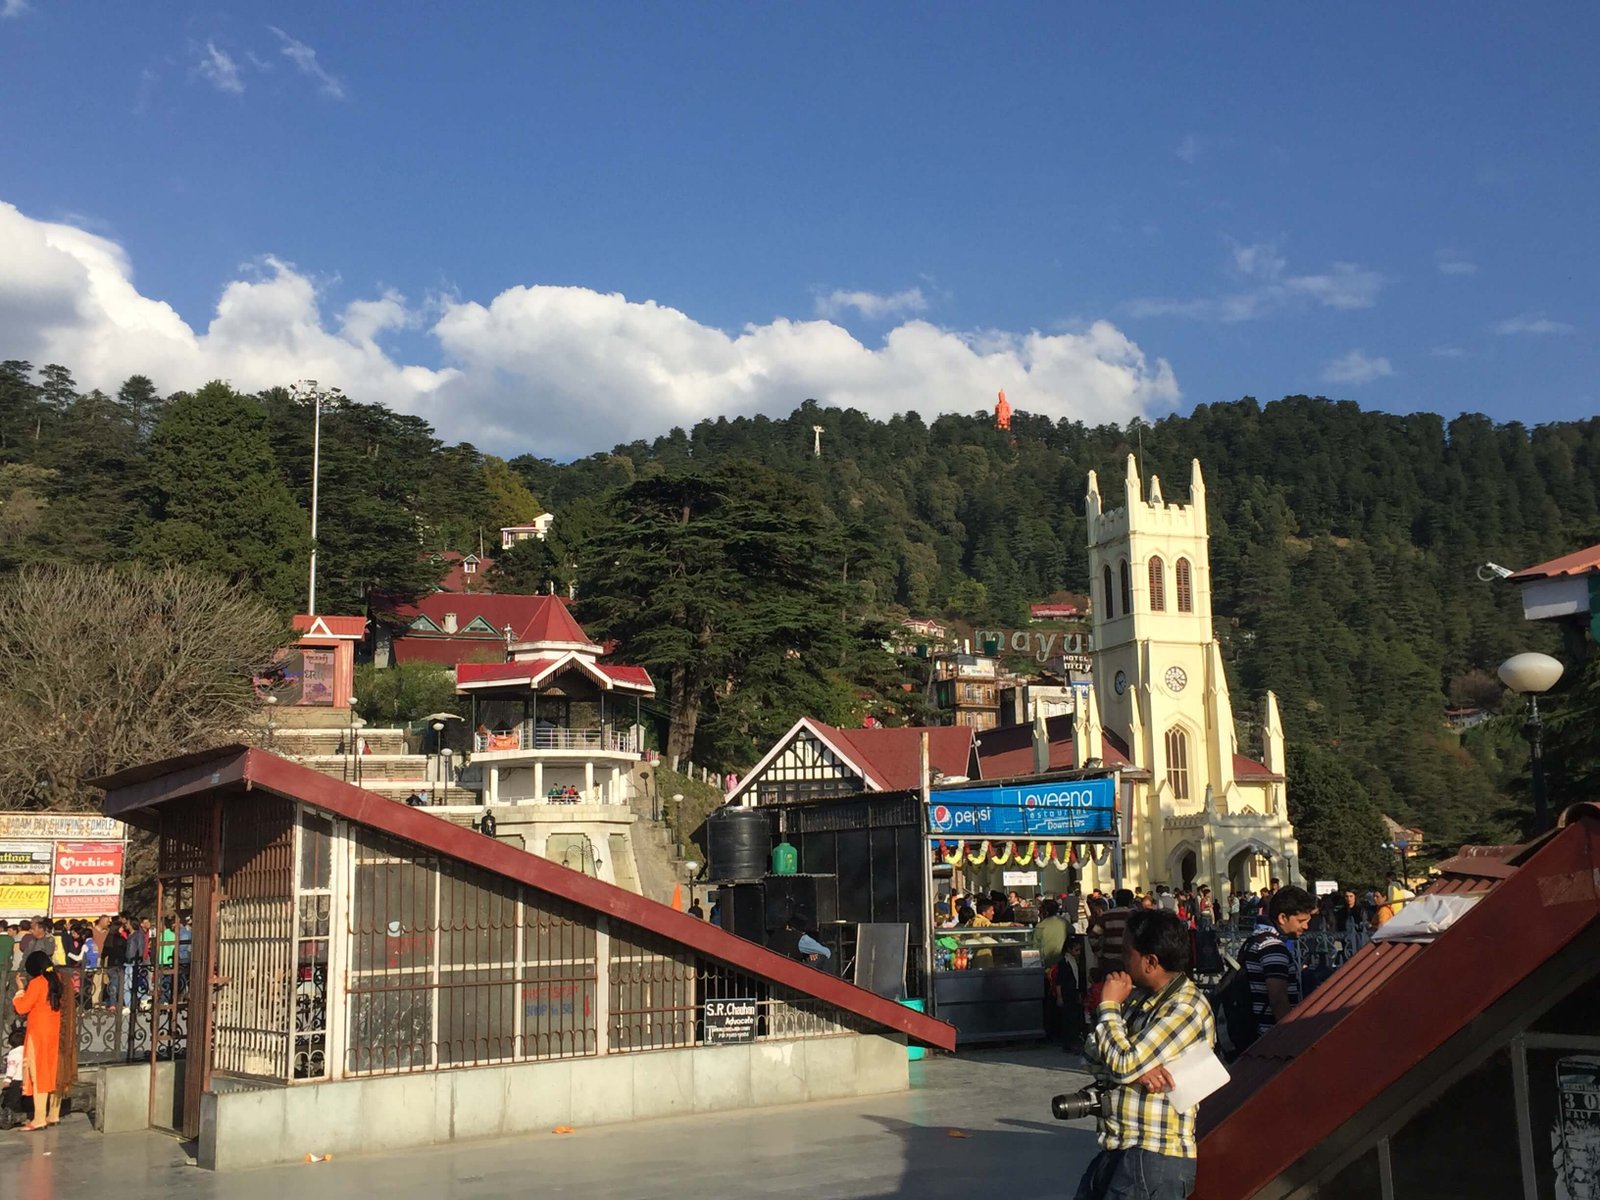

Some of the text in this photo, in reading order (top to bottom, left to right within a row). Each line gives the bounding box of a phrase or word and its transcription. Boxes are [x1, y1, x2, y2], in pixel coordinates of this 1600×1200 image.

[1064, 663, 1091, 673] may
[1017, 789, 1093, 812] Loveena
[955, 806, 991, 827] pepsi
[87, 819, 117, 831] COMPLEX
[60, 877, 115, 887] SPLASH
[1564, 1093, 1576, 1109] 3
